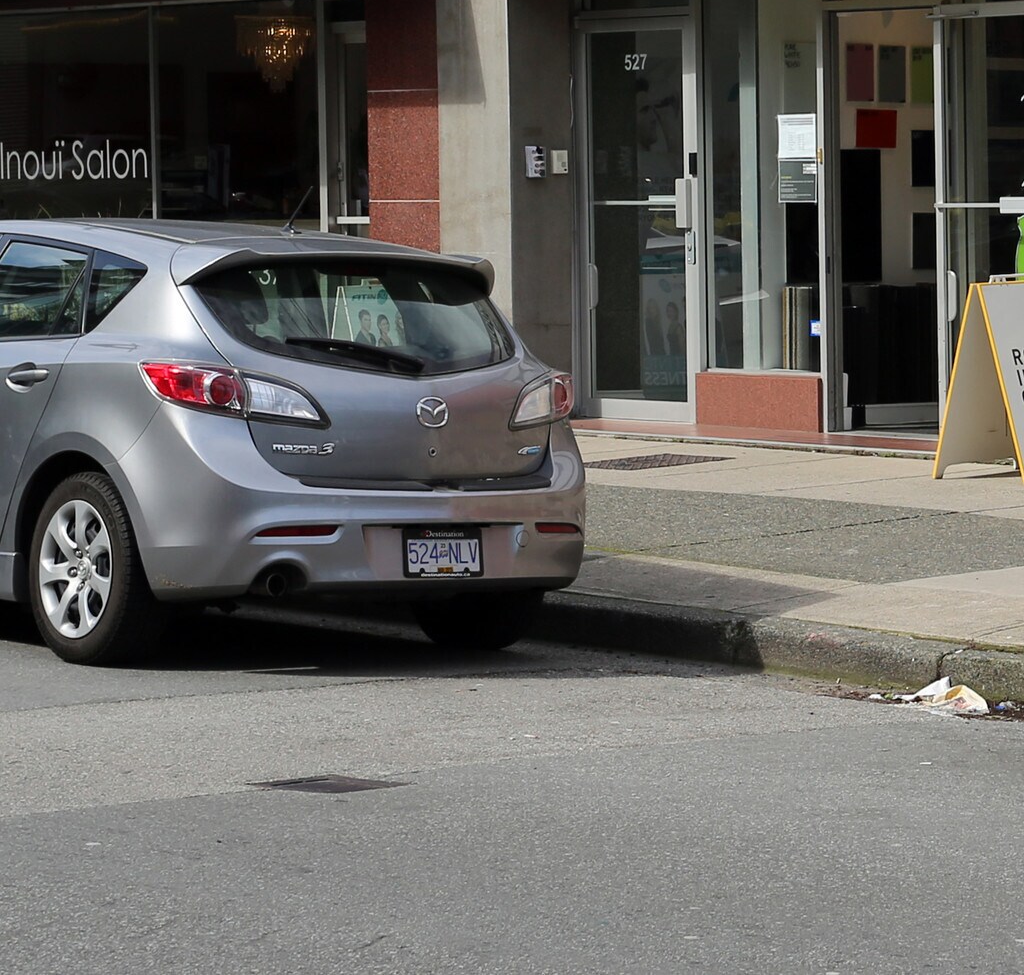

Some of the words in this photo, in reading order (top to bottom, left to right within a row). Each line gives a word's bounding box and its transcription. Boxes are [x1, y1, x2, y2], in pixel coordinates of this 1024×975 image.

[624, 53, 648, 71] 527
[0, 140, 65, 180] Inouï
[71, 139, 148, 180] Salon
[408, 542, 439, 564] 524
[448, 541, 478, 564] NLV
